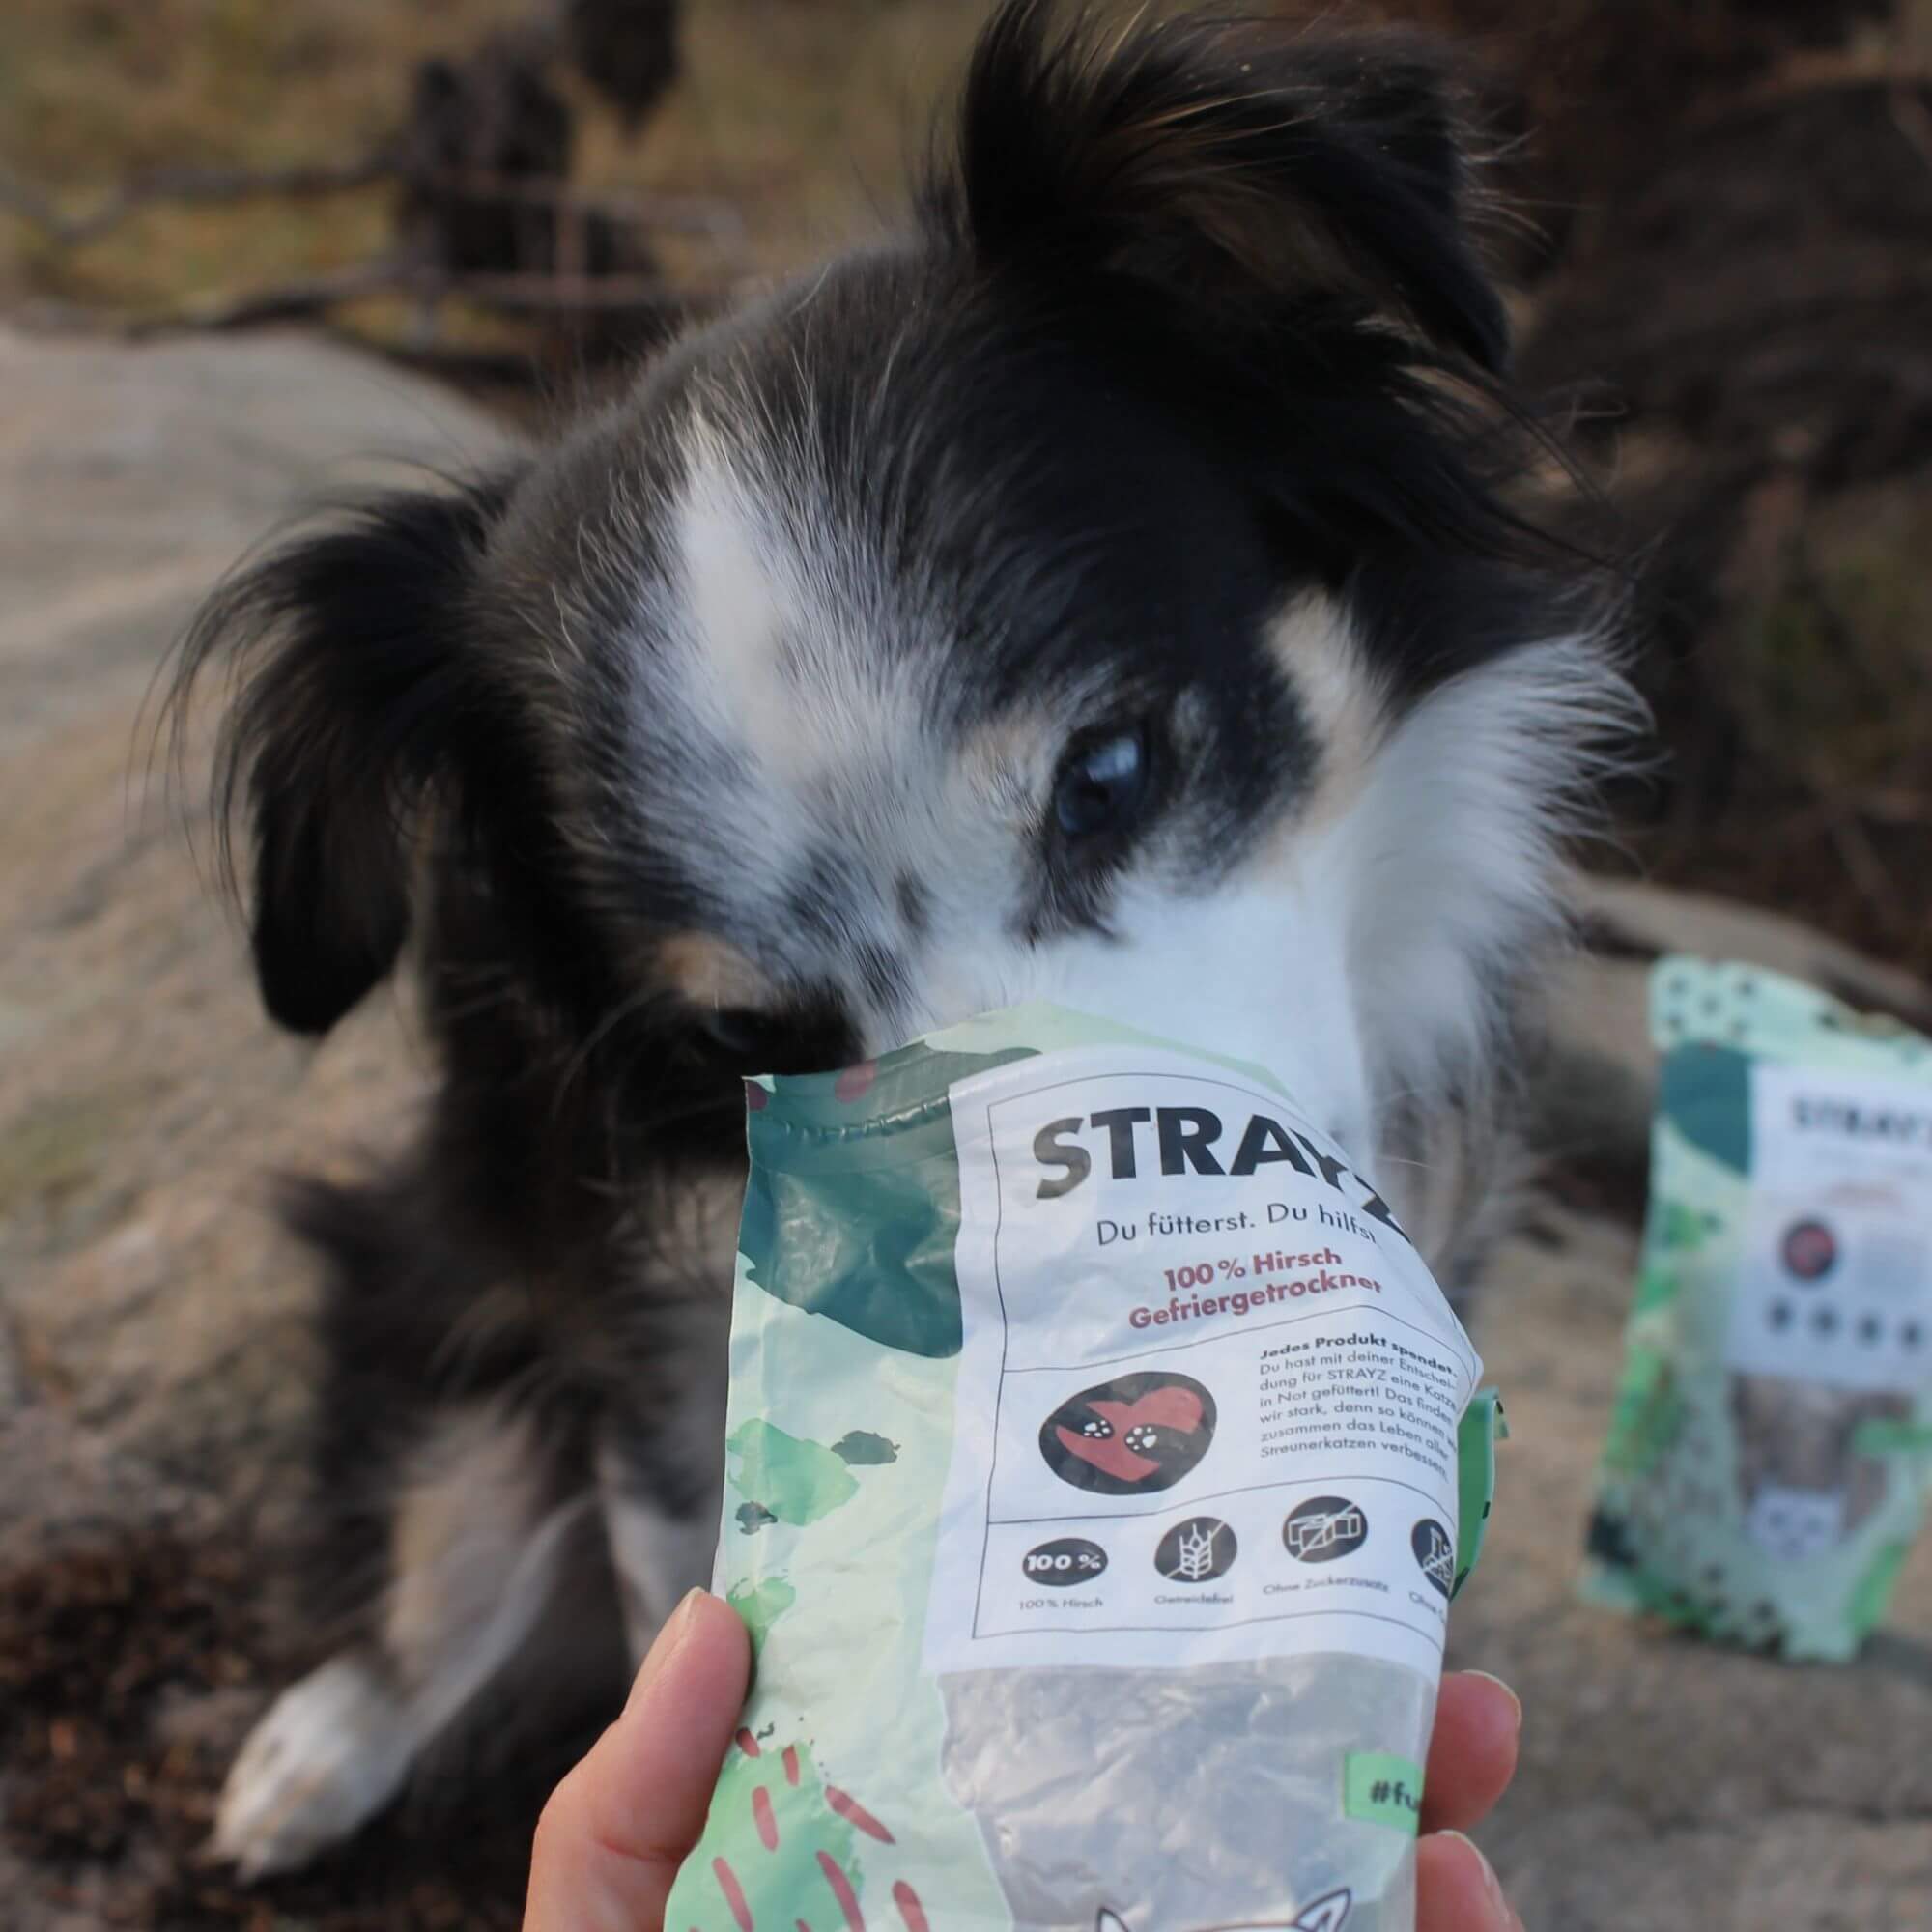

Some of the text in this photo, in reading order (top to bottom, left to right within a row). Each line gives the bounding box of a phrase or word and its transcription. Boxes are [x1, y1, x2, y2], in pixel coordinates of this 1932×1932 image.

[1097, 1220, 1136, 1246] Du
[1148, 1212, 1256, 1236] fütterst.
[1267, 1202, 1308, 1224] Du
[1253, 1246, 1343, 1276] Hirsch
[1128, 1269, 1382, 1330] Gefriergetrocknet
[1260, 1341, 1310, 1360] Jedes
[1315, 1332, 1387, 1349] Produkt
[1260, 1363, 1280, 1376] Du
[1285, 1355, 1316, 1370] hast
[1321, 1352, 1342, 1366] mit
[1347, 1350, 1394, 1366] deiner
[1260, 1378, 1298, 1393] dung
[1302, 1372, 1321, 1385] für
[1327, 1367, 1387, 1382] STRAYZ
[1391, 1375, 1421, 1392] eine
[1260, 1397, 1272, 1408] in
[1278, 1390, 1306, 1404] Not
[1385, 1387, 1413, 1406] Das
[1260, 1400, 1445, 1440] wir stark, denn so können
[1261, 1422, 1342, 1442] zusammen
[1346, 1417, 1376, 1432] das
[1379, 1420, 1423, 1444] Leben
[1261, 1436, 1377, 1458] Streunerkatzen
[1027, 1553, 1102, 1571] 100 %
[1263, 1583, 1301, 1595] Ohne
[1063, 1597, 1103, 1608] Hirsch
